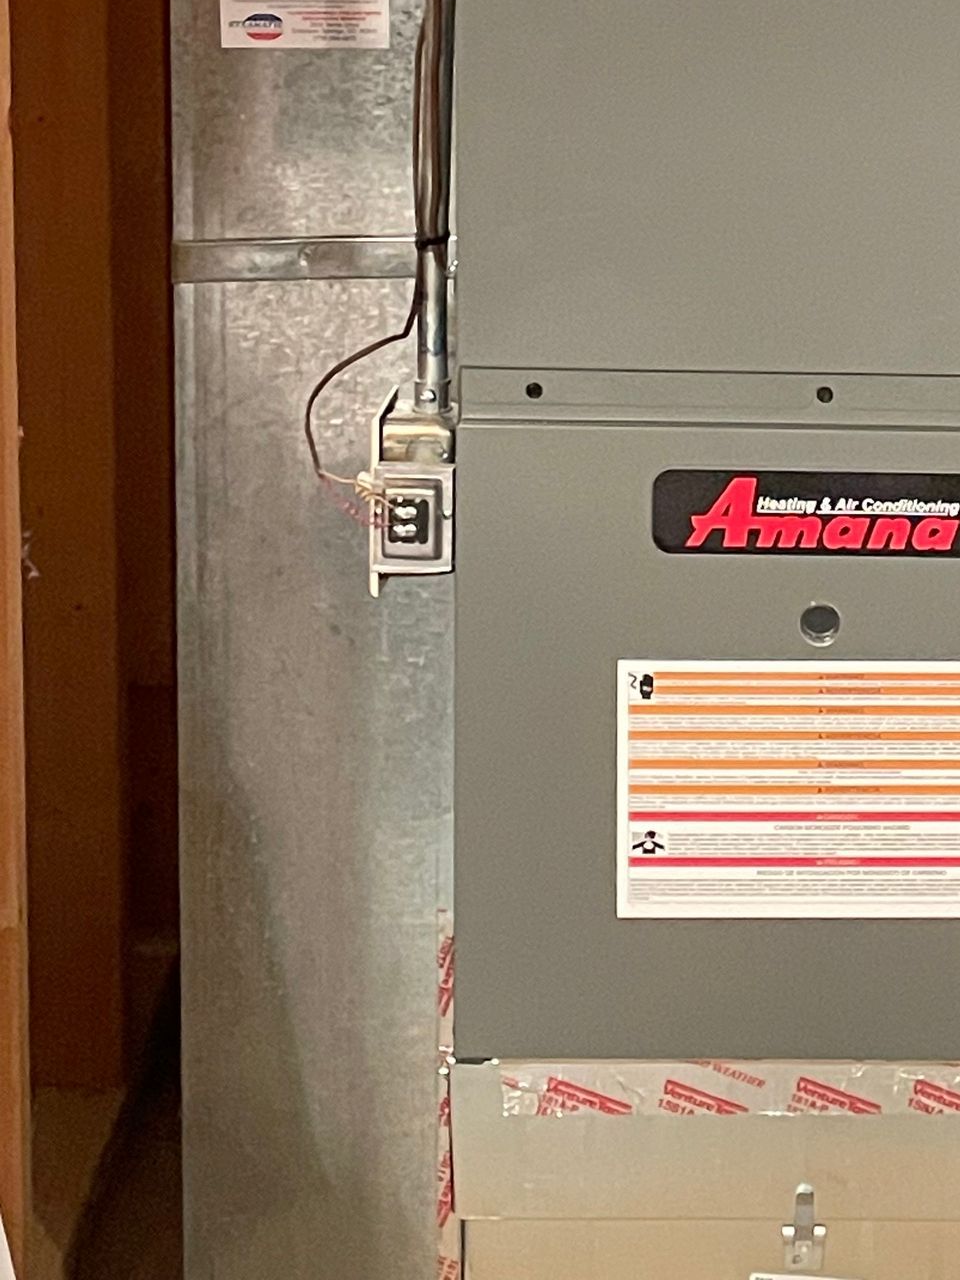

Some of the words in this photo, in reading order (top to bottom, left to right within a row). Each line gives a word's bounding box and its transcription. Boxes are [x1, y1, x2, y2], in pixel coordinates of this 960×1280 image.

[685, 477, 960, 551] Amana
[757, 496, 817, 514] Heating
[820, 497, 832, 511] &
[834, 497, 859, 511] Air
[861, 497, 960, 517] Conditioning
[664, 1080, 716, 1112] Venture
[796, 1077, 849, 1109] Venture
